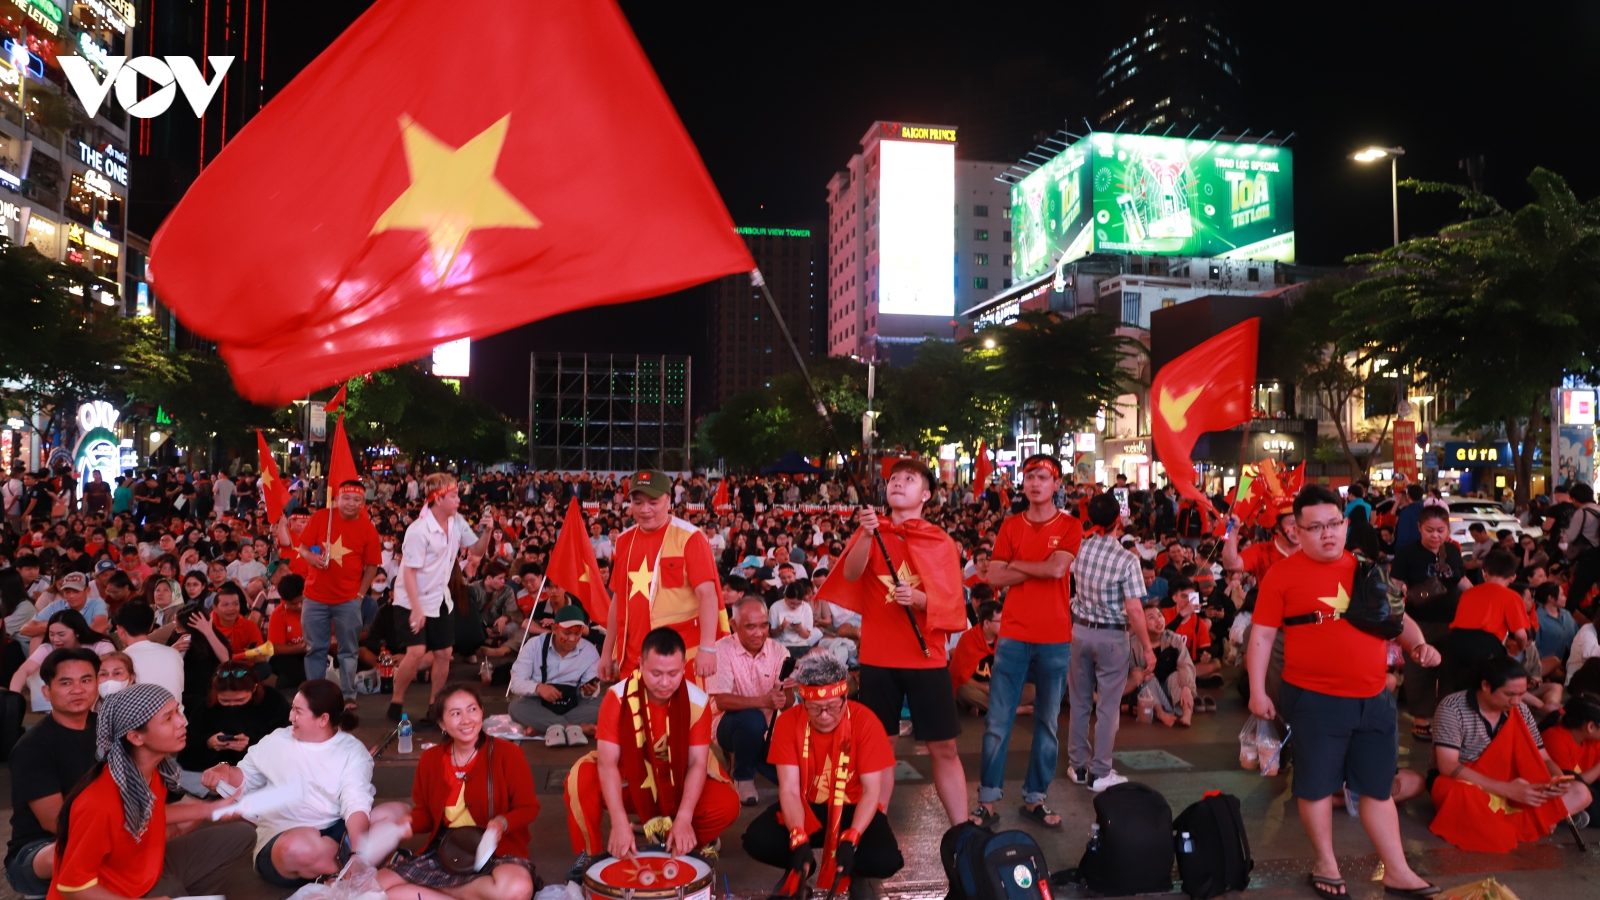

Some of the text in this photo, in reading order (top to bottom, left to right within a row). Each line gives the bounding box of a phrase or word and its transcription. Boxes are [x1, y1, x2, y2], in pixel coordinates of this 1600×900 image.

[27, 4, 59, 36] LETTER
[902, 126, 957, 142] SAIGON PRINCE
[78, 140, 104, 172] THE
[104, 158, 128, 186] ONE
[733, 226, 811, 238] HARBOUR VIEW TOWER
